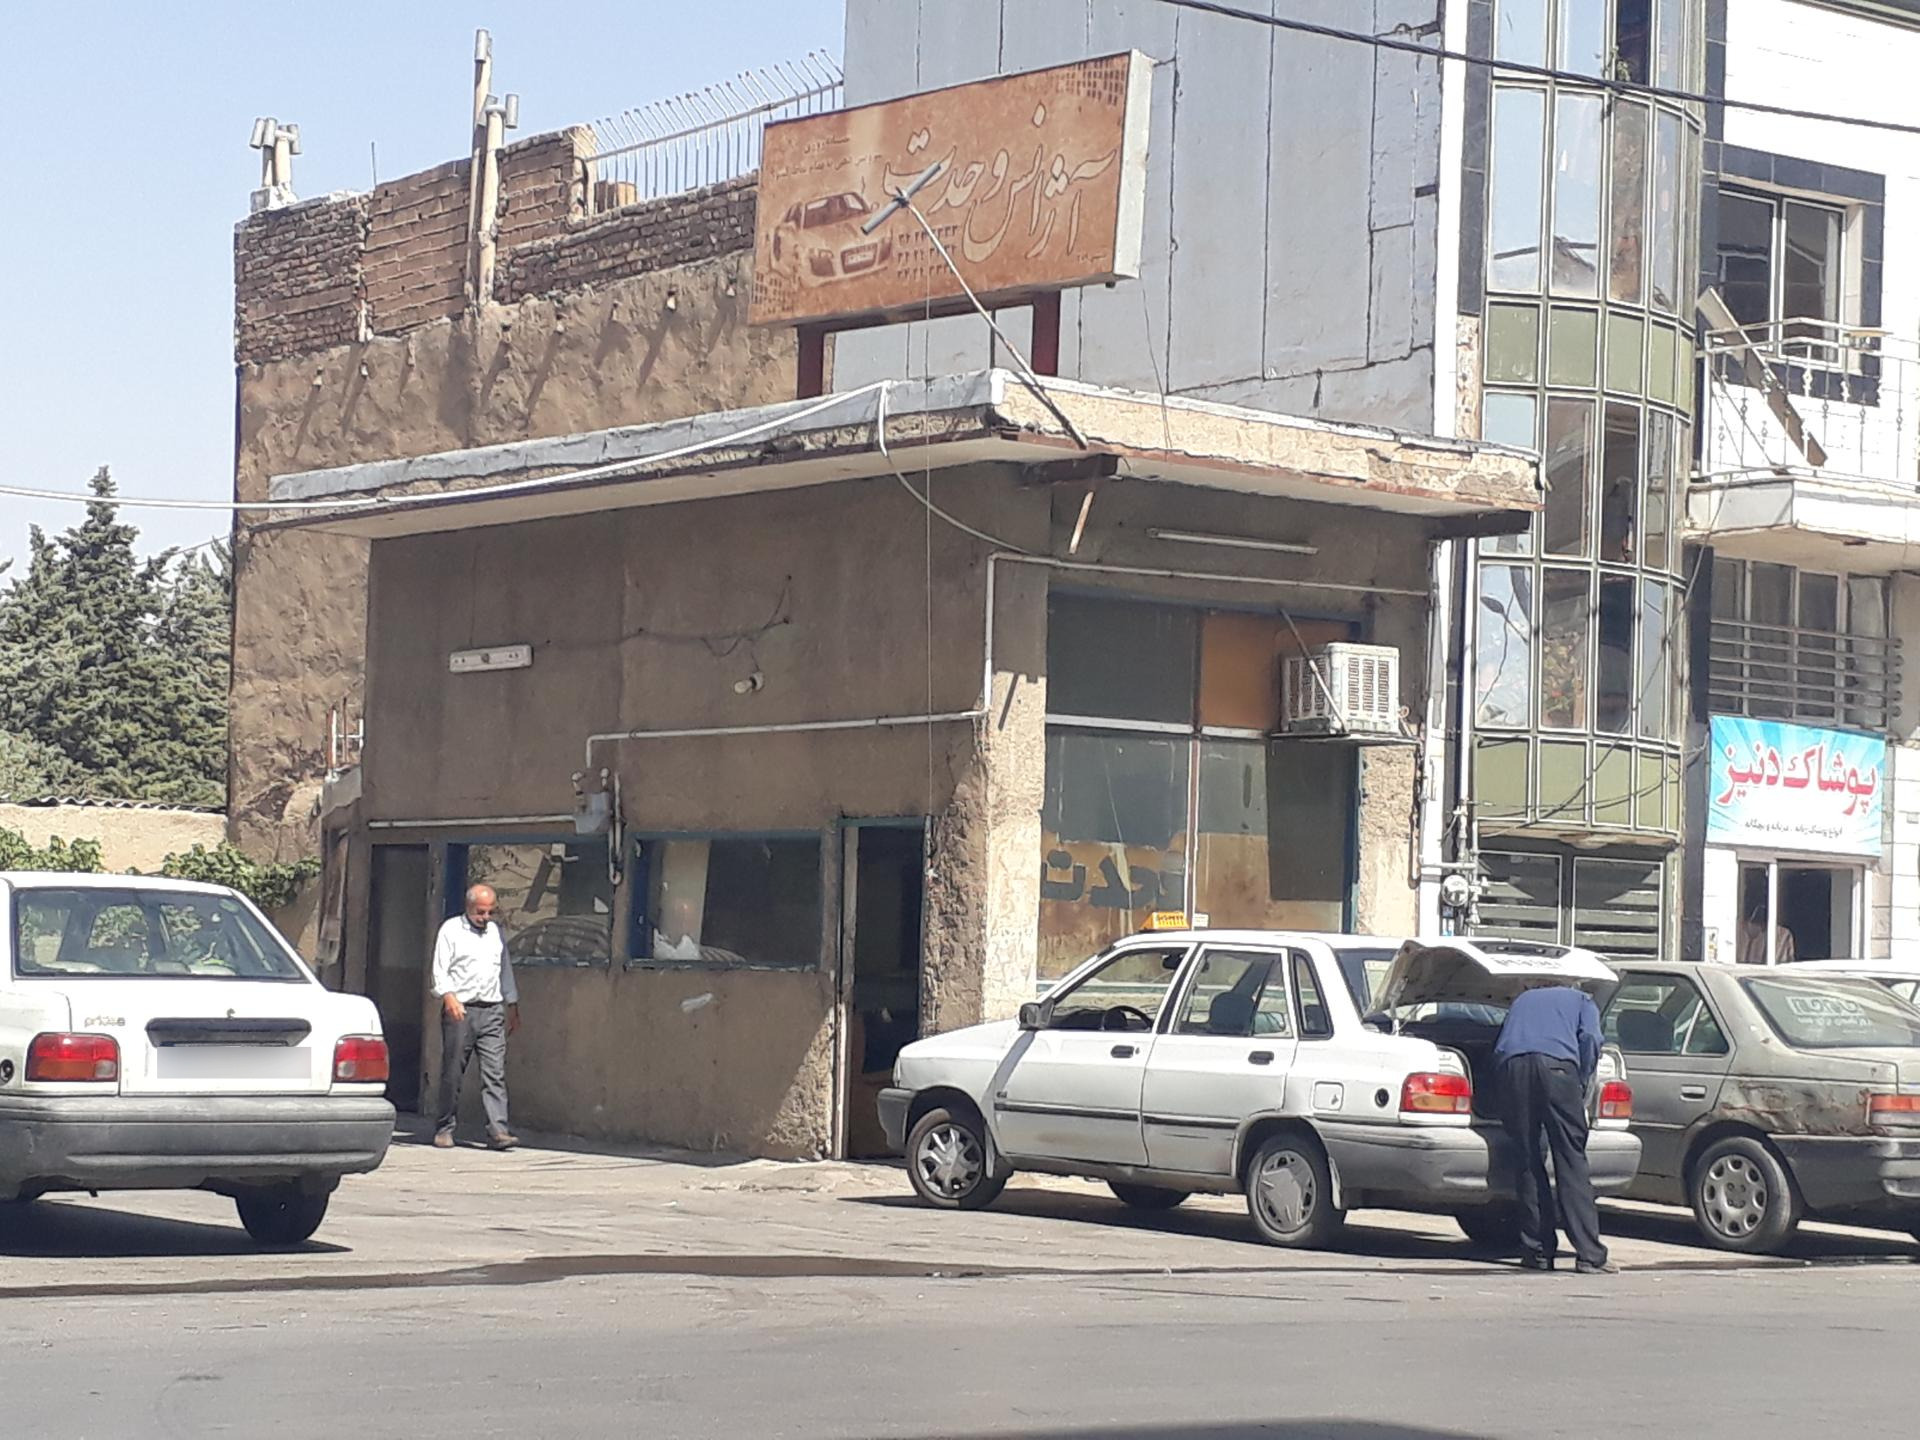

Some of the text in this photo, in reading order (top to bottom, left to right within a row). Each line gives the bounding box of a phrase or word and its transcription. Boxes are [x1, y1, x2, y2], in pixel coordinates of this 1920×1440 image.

[882, 101, 1116, 263] آژانس وحدت
[1717, 742, 1876, 816] پوشاک دنیز
